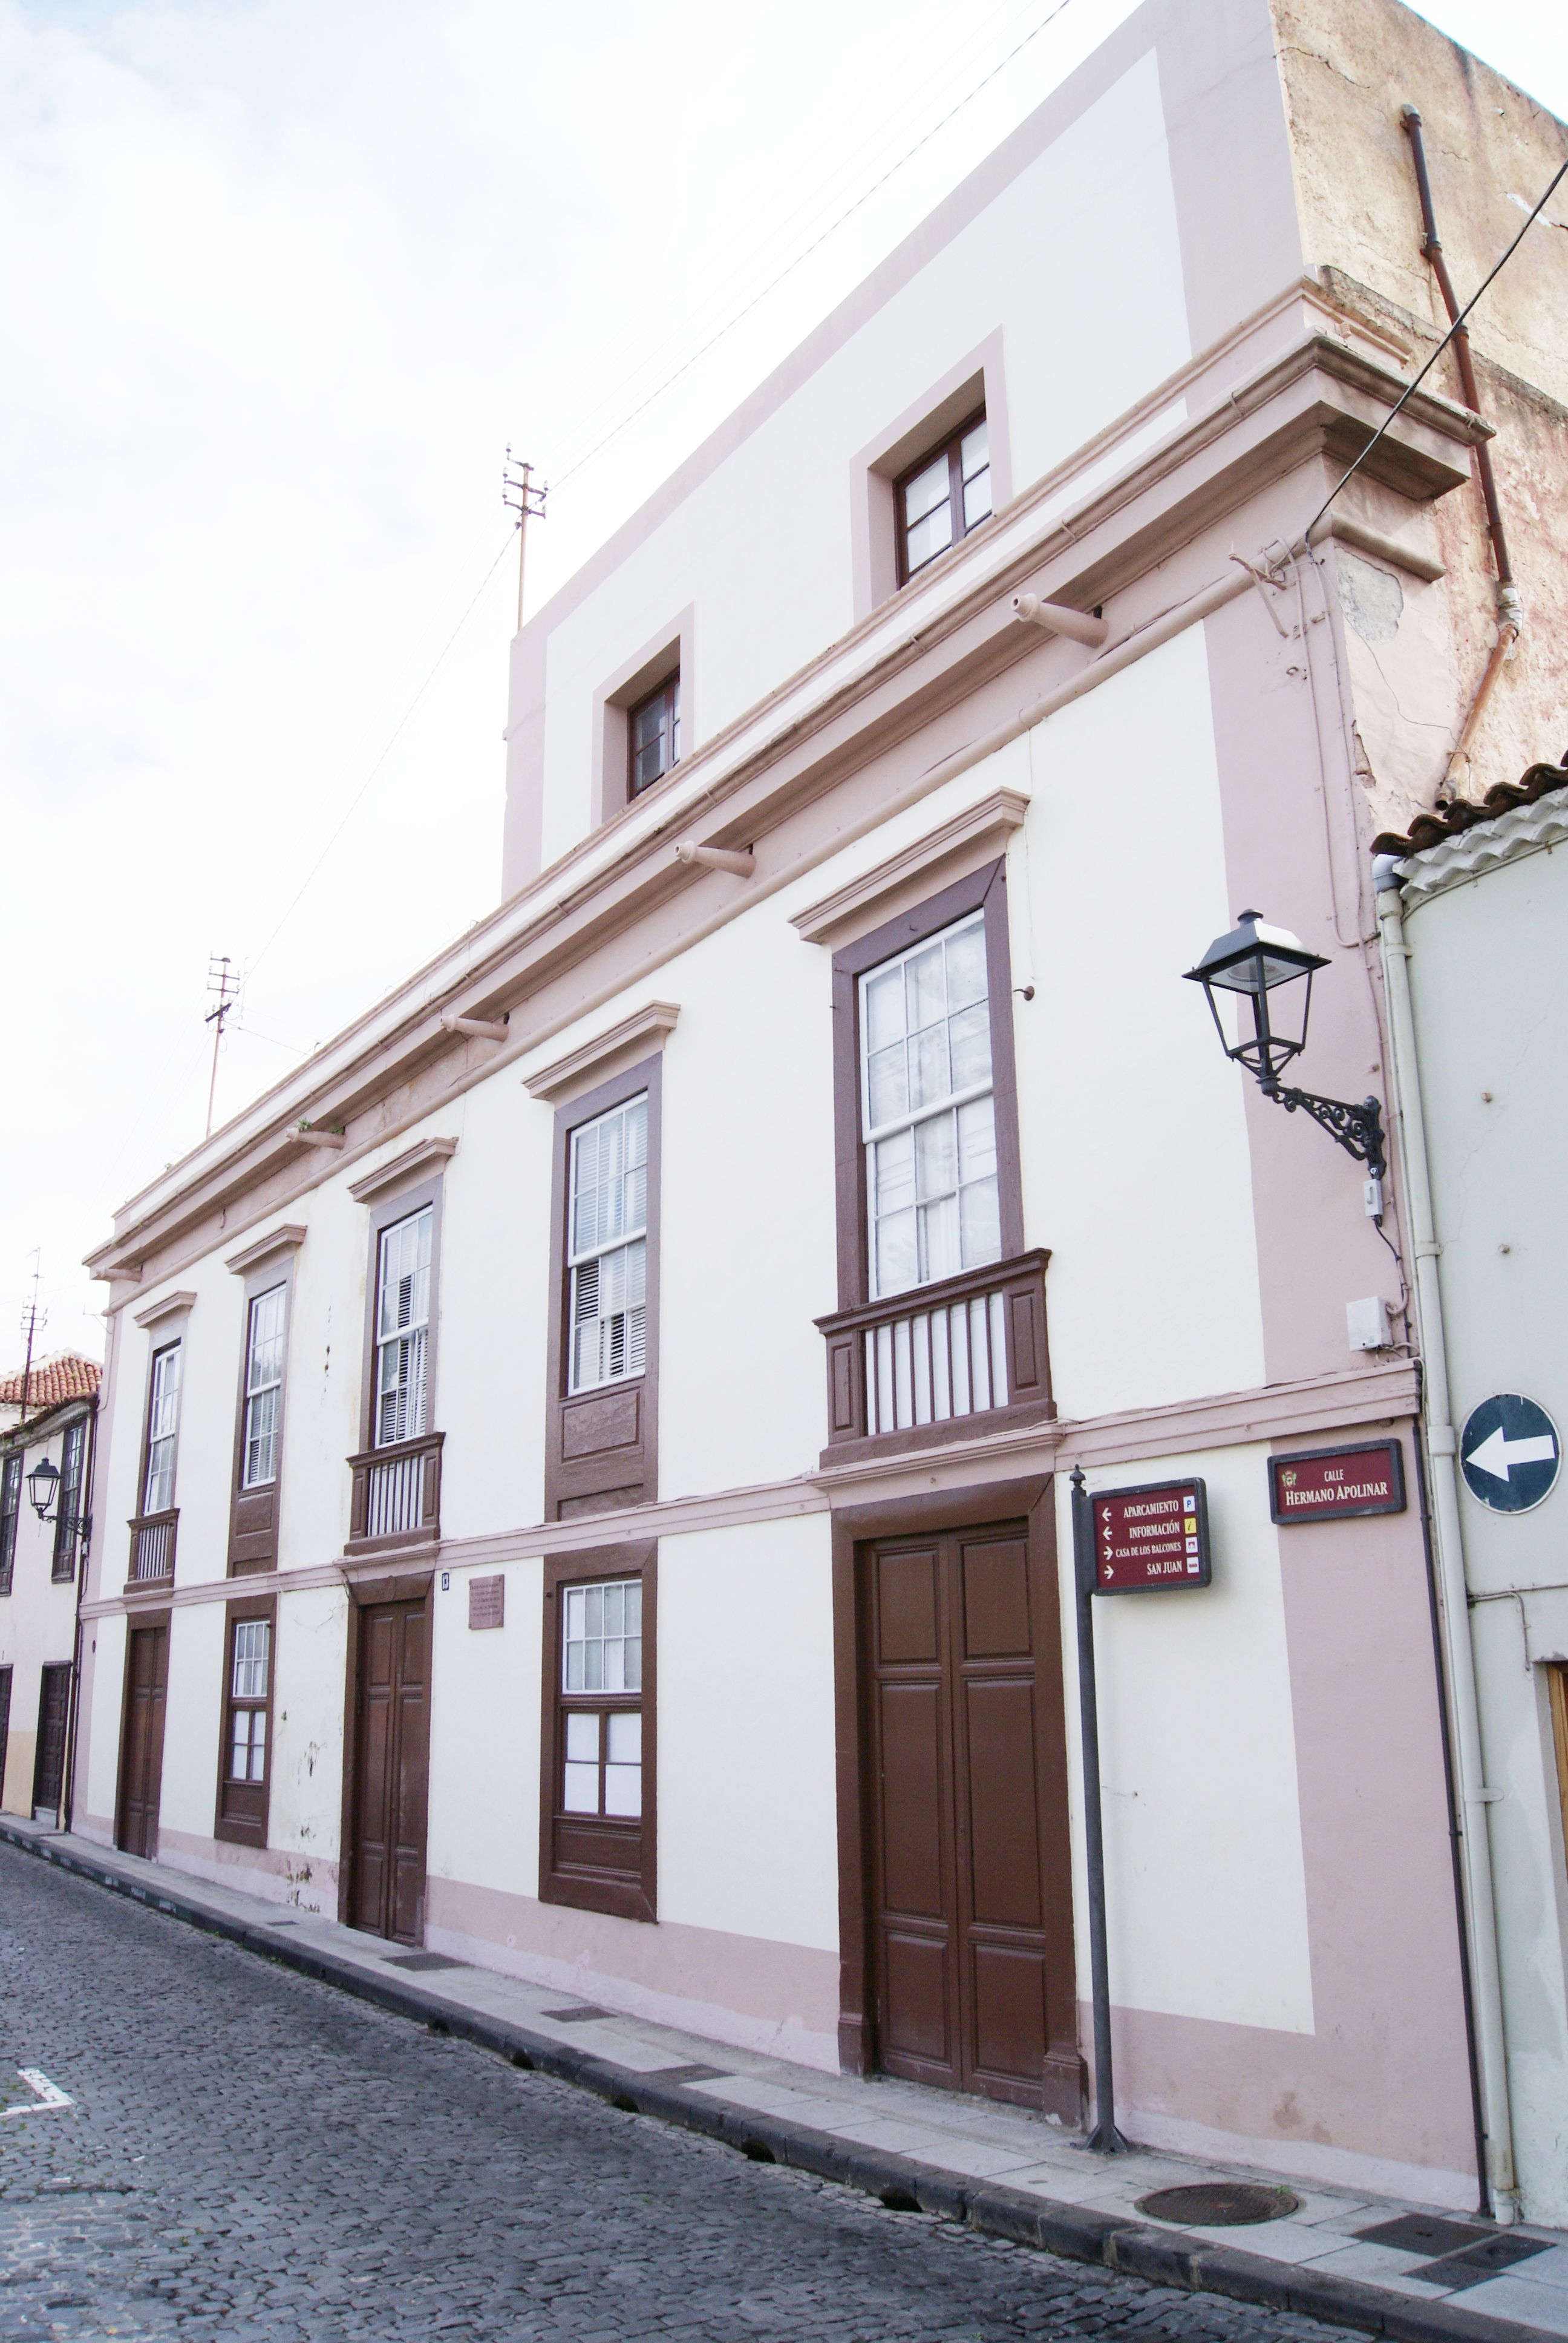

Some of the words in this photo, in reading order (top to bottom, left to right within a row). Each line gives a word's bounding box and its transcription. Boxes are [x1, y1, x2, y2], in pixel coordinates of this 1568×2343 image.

[1324, 1469, 1344, 1481] CALLE
[1285, 1488, 1334, 1506] HERMANO
[1337, 1482, 1388, 1500] APOLINAR
[1123, 1500, 1179, 1518] APARCAMIENTO
[1129, 1519, 1180, 1538] INFORMACIÓN
[1116, 1548, 1130, 1558] CASA
[1131, 1547, 1138, 1556] DE
[1140, 1544, 1151, 1555] LOS
[1151, 1542, 1181, 1554] BALCONES
[1147, 1563, 1161, 1575] SAN
[1163, 1561, 1183, 1573] JUAN
